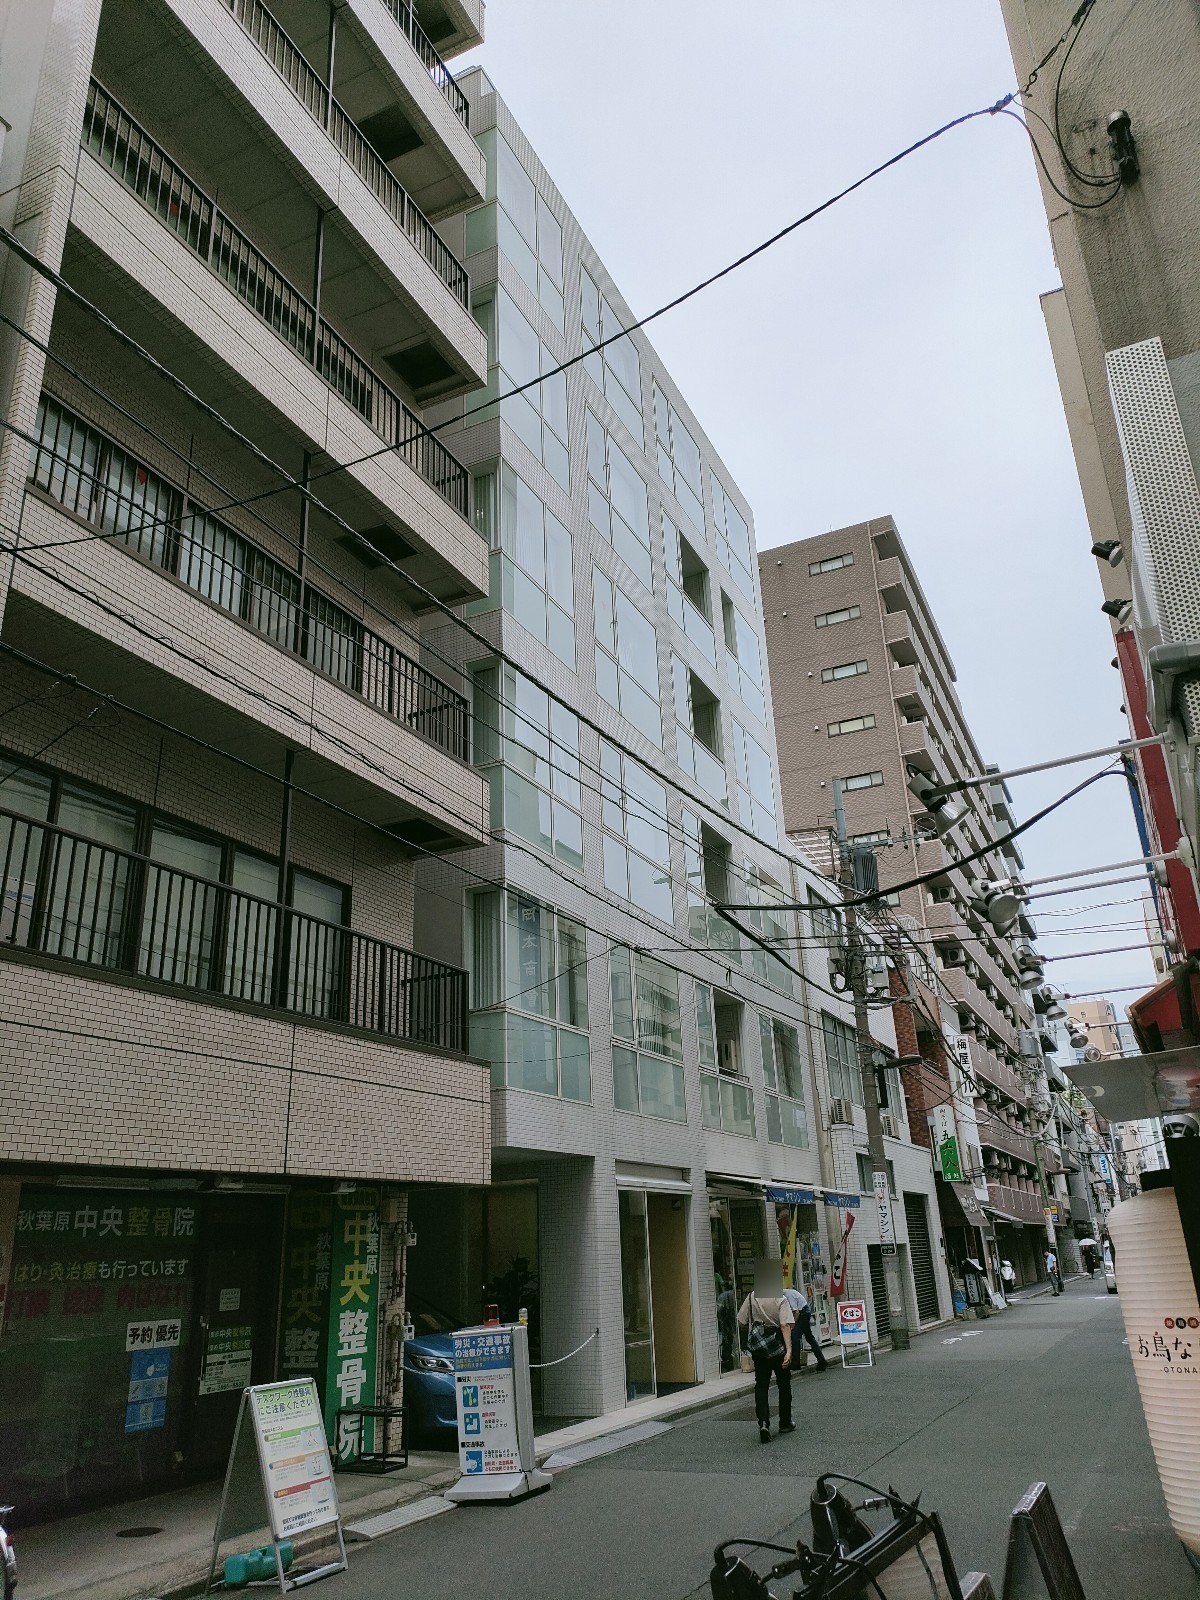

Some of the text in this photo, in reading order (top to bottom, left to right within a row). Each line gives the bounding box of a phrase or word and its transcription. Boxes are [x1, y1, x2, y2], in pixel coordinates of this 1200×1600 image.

[522, 906, 539, 1007] 岡本商會
[17, 1204, 195, 1238] 秋葉原中央整骨院
[878, 1204, 890, 1234] ヤマシン
[366, 1212, 379, 1275] 秋葉原
[14, 1258, 190, 1282] はり・灸治療も行っています
[843, 1309, 860, 1318] たばこ
[128, 1323, 180, 1345] 予約優先
[454, 1335, 511, 1349] 労災・交通事故
[455, 1346, 511, 1358] の治療ができます
[258, 1398, 314, 1416] にご注意ください
